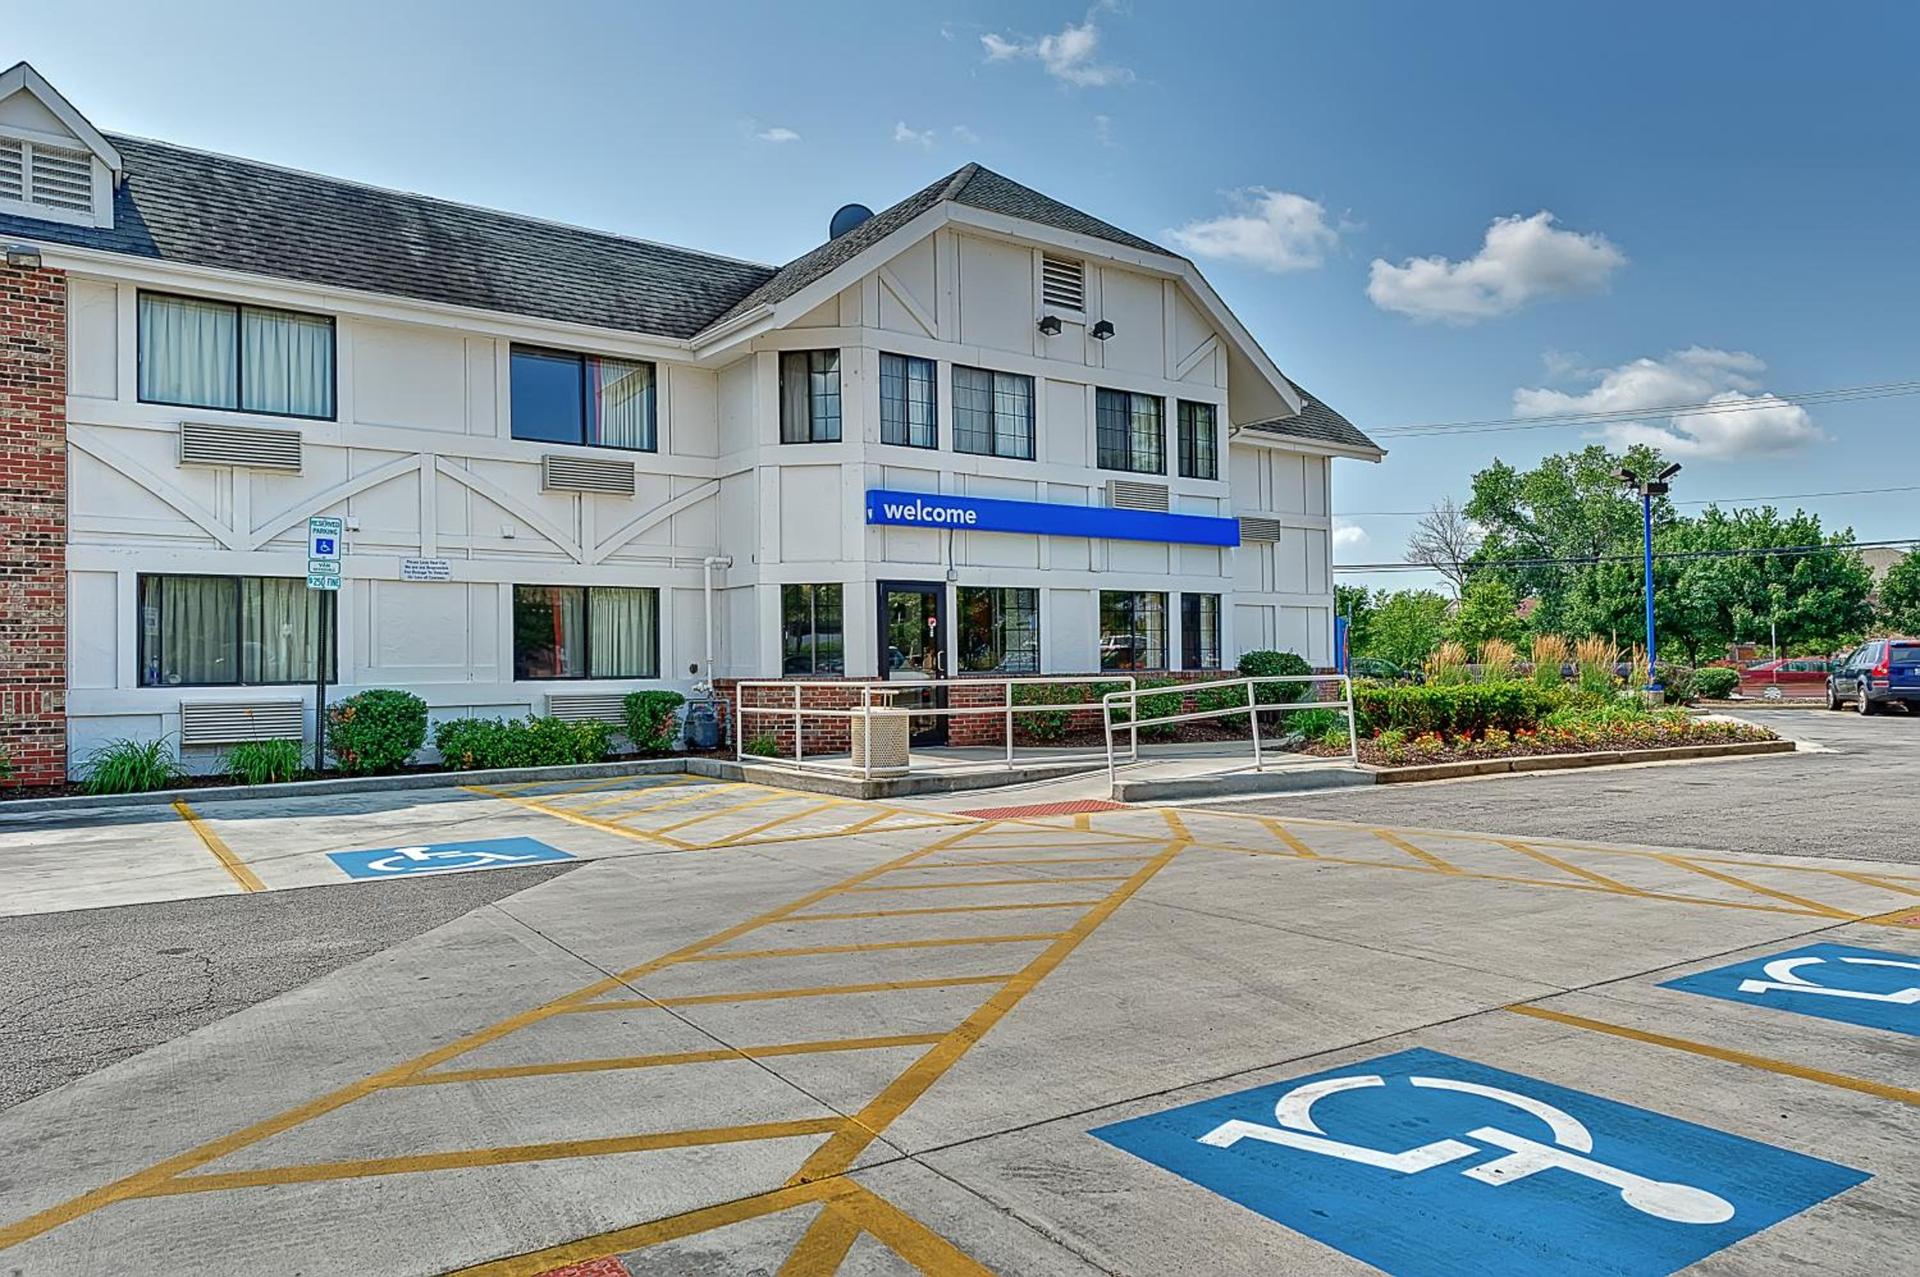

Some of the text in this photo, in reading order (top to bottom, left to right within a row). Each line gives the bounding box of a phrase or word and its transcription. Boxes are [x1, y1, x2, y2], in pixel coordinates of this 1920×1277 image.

[883, 499, 977, 524] welcome
[311, 520, 340, 528] RESERVED
[326, 577, 341, 587] FINE
